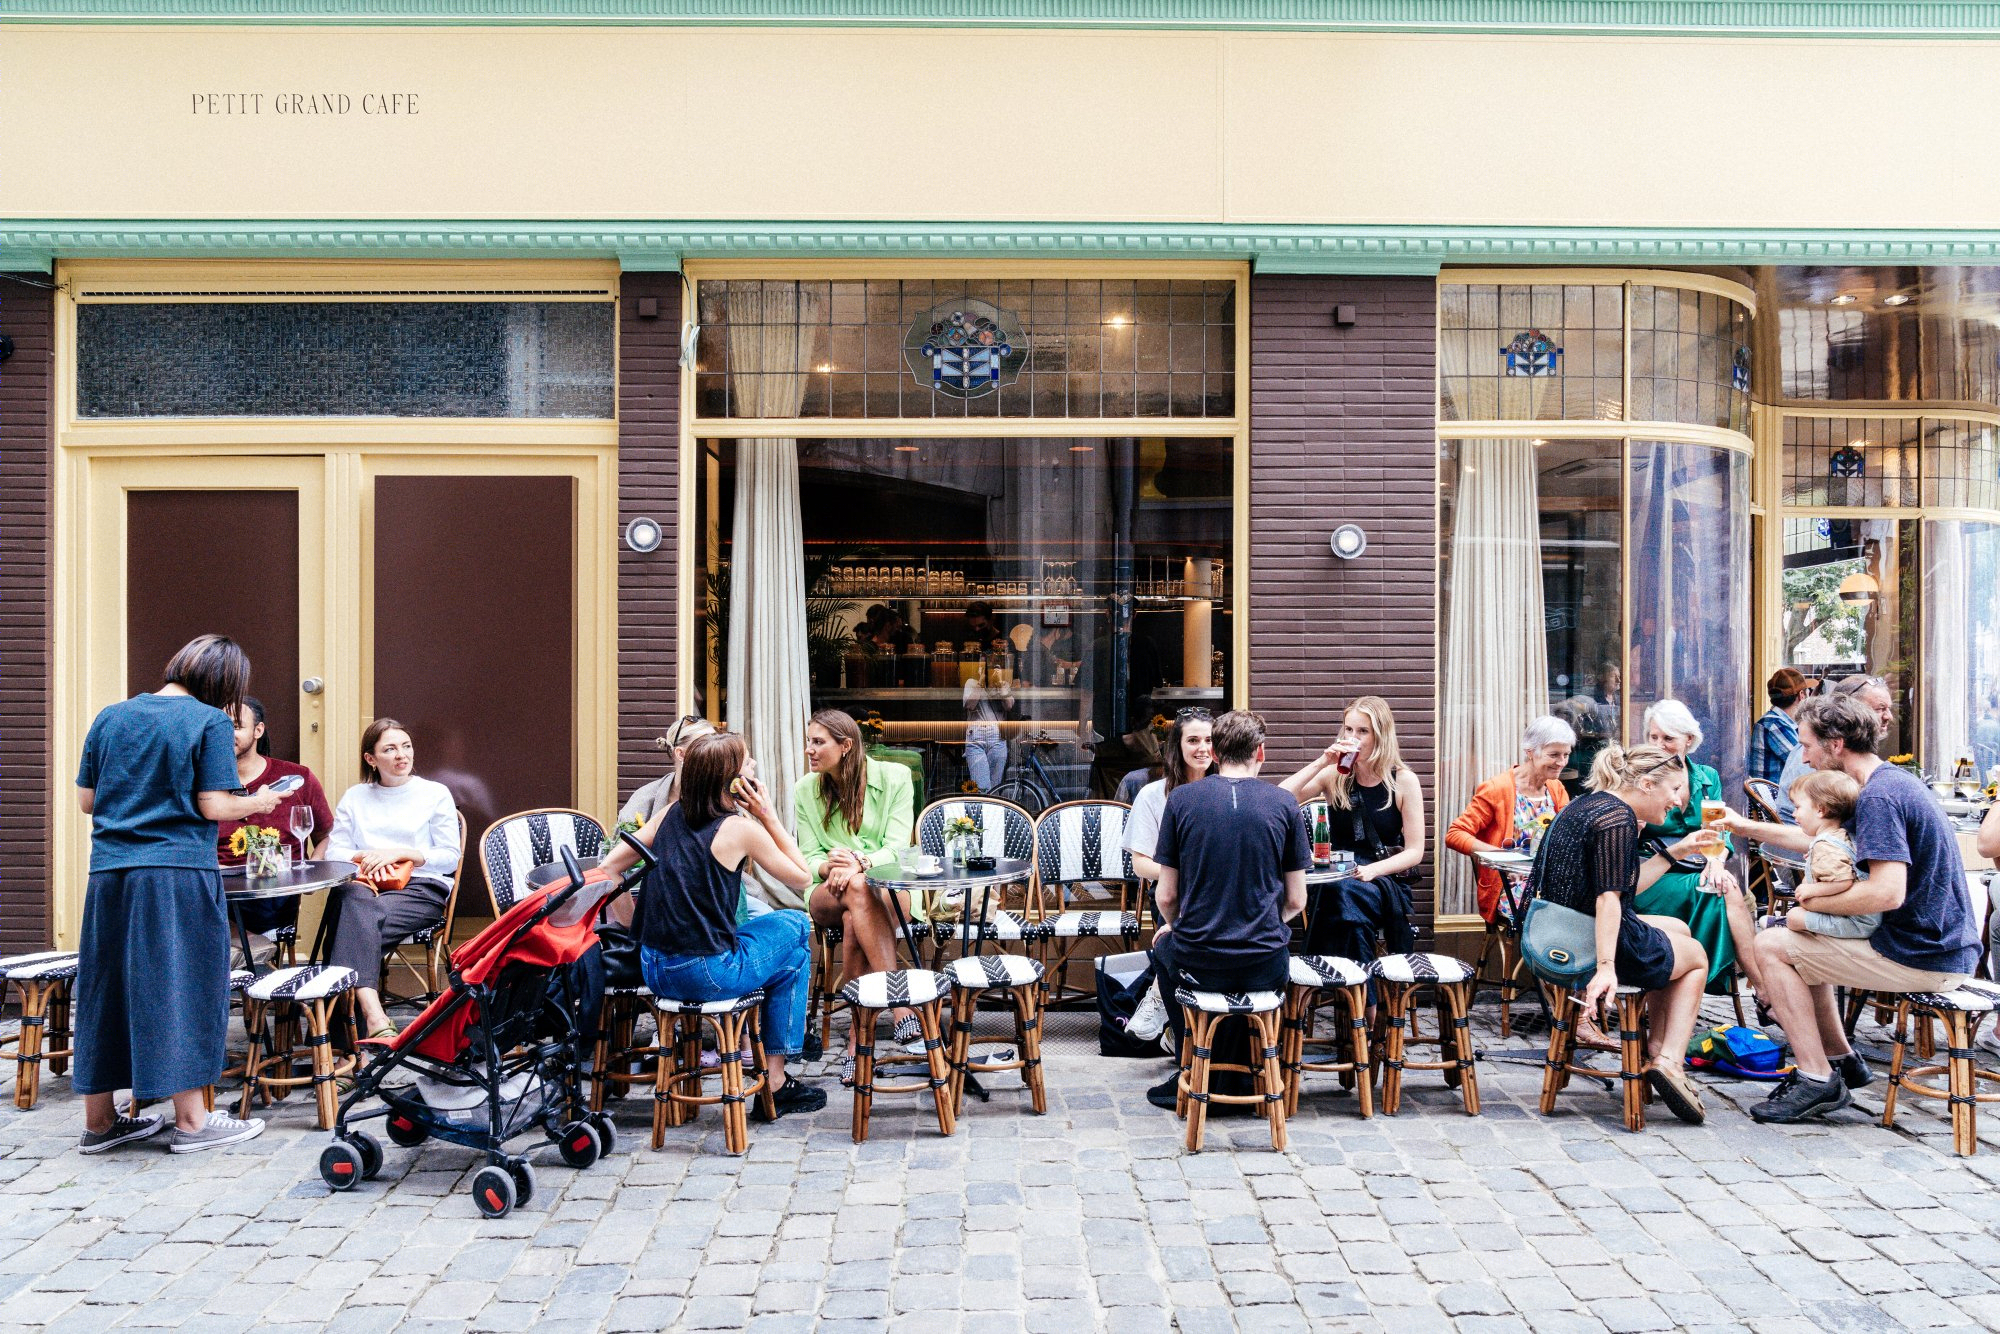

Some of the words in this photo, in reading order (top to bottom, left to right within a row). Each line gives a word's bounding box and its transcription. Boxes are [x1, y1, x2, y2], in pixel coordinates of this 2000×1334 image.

[191, 93, 264, 115] PETIT
[275, 93, 351, 115] GRAND
[362, 93, 420, 115] CAFE
